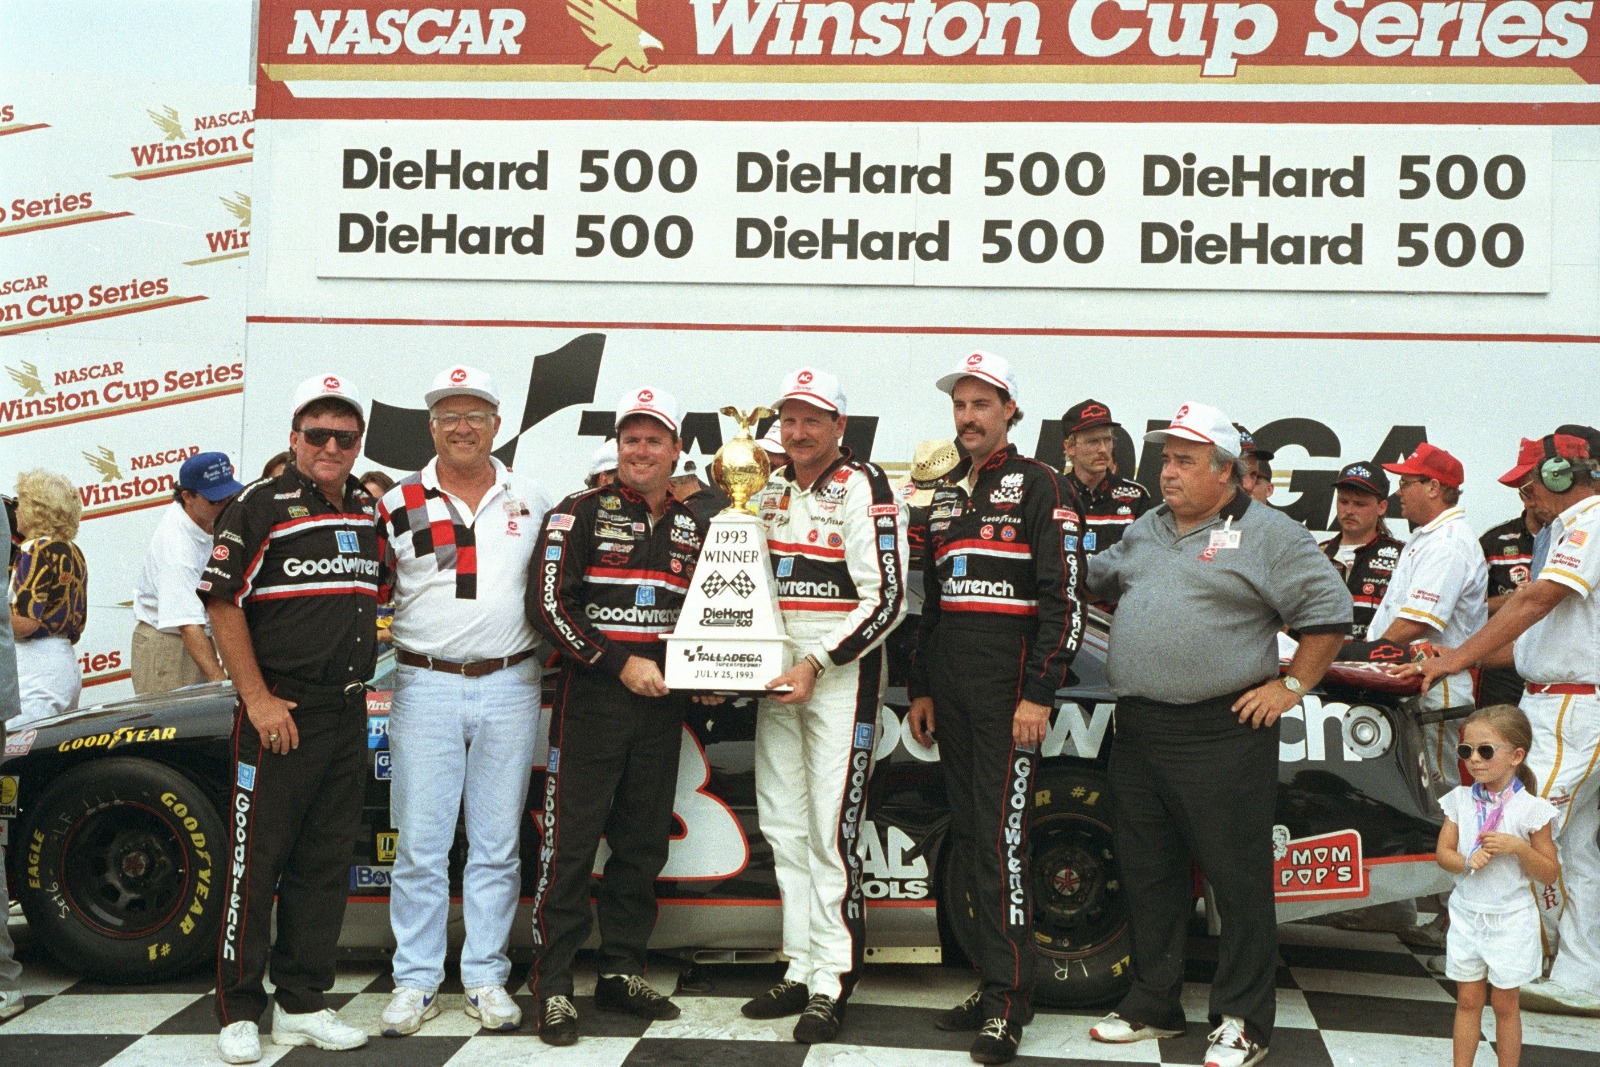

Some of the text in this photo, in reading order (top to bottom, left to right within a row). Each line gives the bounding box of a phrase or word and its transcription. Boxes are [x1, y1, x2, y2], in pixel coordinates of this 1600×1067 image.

[287, 0, 1593, 77] NASCAR Winston Cup Series
[131, 130, 238, 167] Winston
[342, 147, 1526, 200] DieHard 500 DieHard 500 DieHard 500
[12, 192, 93, 222] Series
[338, 210, 1524, 268] DieHard 500 DieHard 500 DieHard 500
[27, 293, 83, 316] Cup
[89, 277, 169, 307] Series
[54, 361, 124, 386] NASCAR
[0, 363, 243, 423] Winston Cup Series
[78, 473, 176, 506] Winston
[981, 514, 1021, 524] GOODYEAR
[715, 530, 748, 544] 1993
[283, 555, 379, 577] Goodwren
[704, 550, 759, 563] WINNER
[776, 581, 840, 597] wrench
[942, 577, 1014, 597] dwrench
[585, 602, 681, 623] Goodwrenc
[703, 607, 754, 619] DieHard
[736, 619, 753, 628] 500
[78, 650, 121, 674] ries
[697, 652, 763, 663] TALLADEGA
[694, 670, 754, 680] JULY 25, 1993
[58, 726, 177, 752] GOODYEAR
[842, 751, 868, 919] Goodwrench
[1004, 757, 1032, 926] Goodwrench
[29, 828, 46, 890] EAGLE
[859, 821, 929, 879] AC
[1291, 845, 1352, 866] MOM
[160, 792, 212, 935] GOODYEAR
[1280, 865, 1353, 887] POP'S
[222, 792, 250, 961] Goodwrench
[861, 880, 929, 899] OLS
